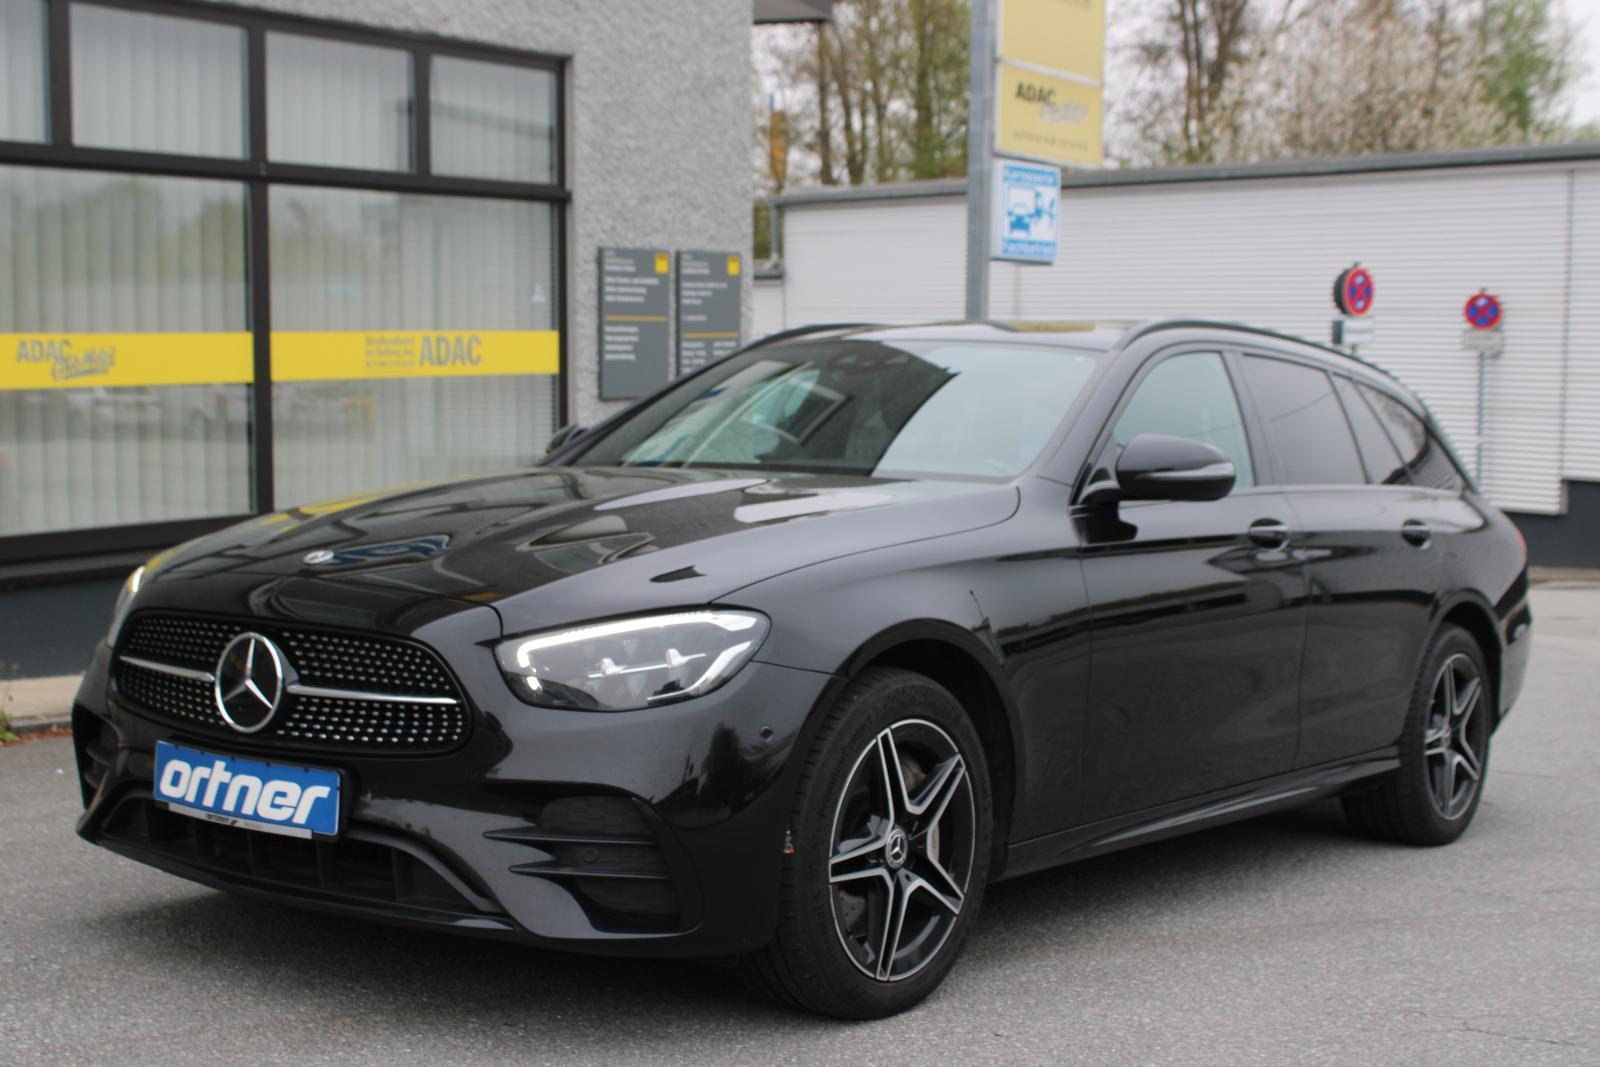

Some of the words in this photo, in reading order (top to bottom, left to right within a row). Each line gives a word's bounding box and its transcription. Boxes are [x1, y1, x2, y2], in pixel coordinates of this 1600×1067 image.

[1015, 81, 1056, 105] ADAC
[17, 338, 72, 364] ADAC
[419, 335, 482, 367] ADAC
[159, 759, 331, 825] ortner
